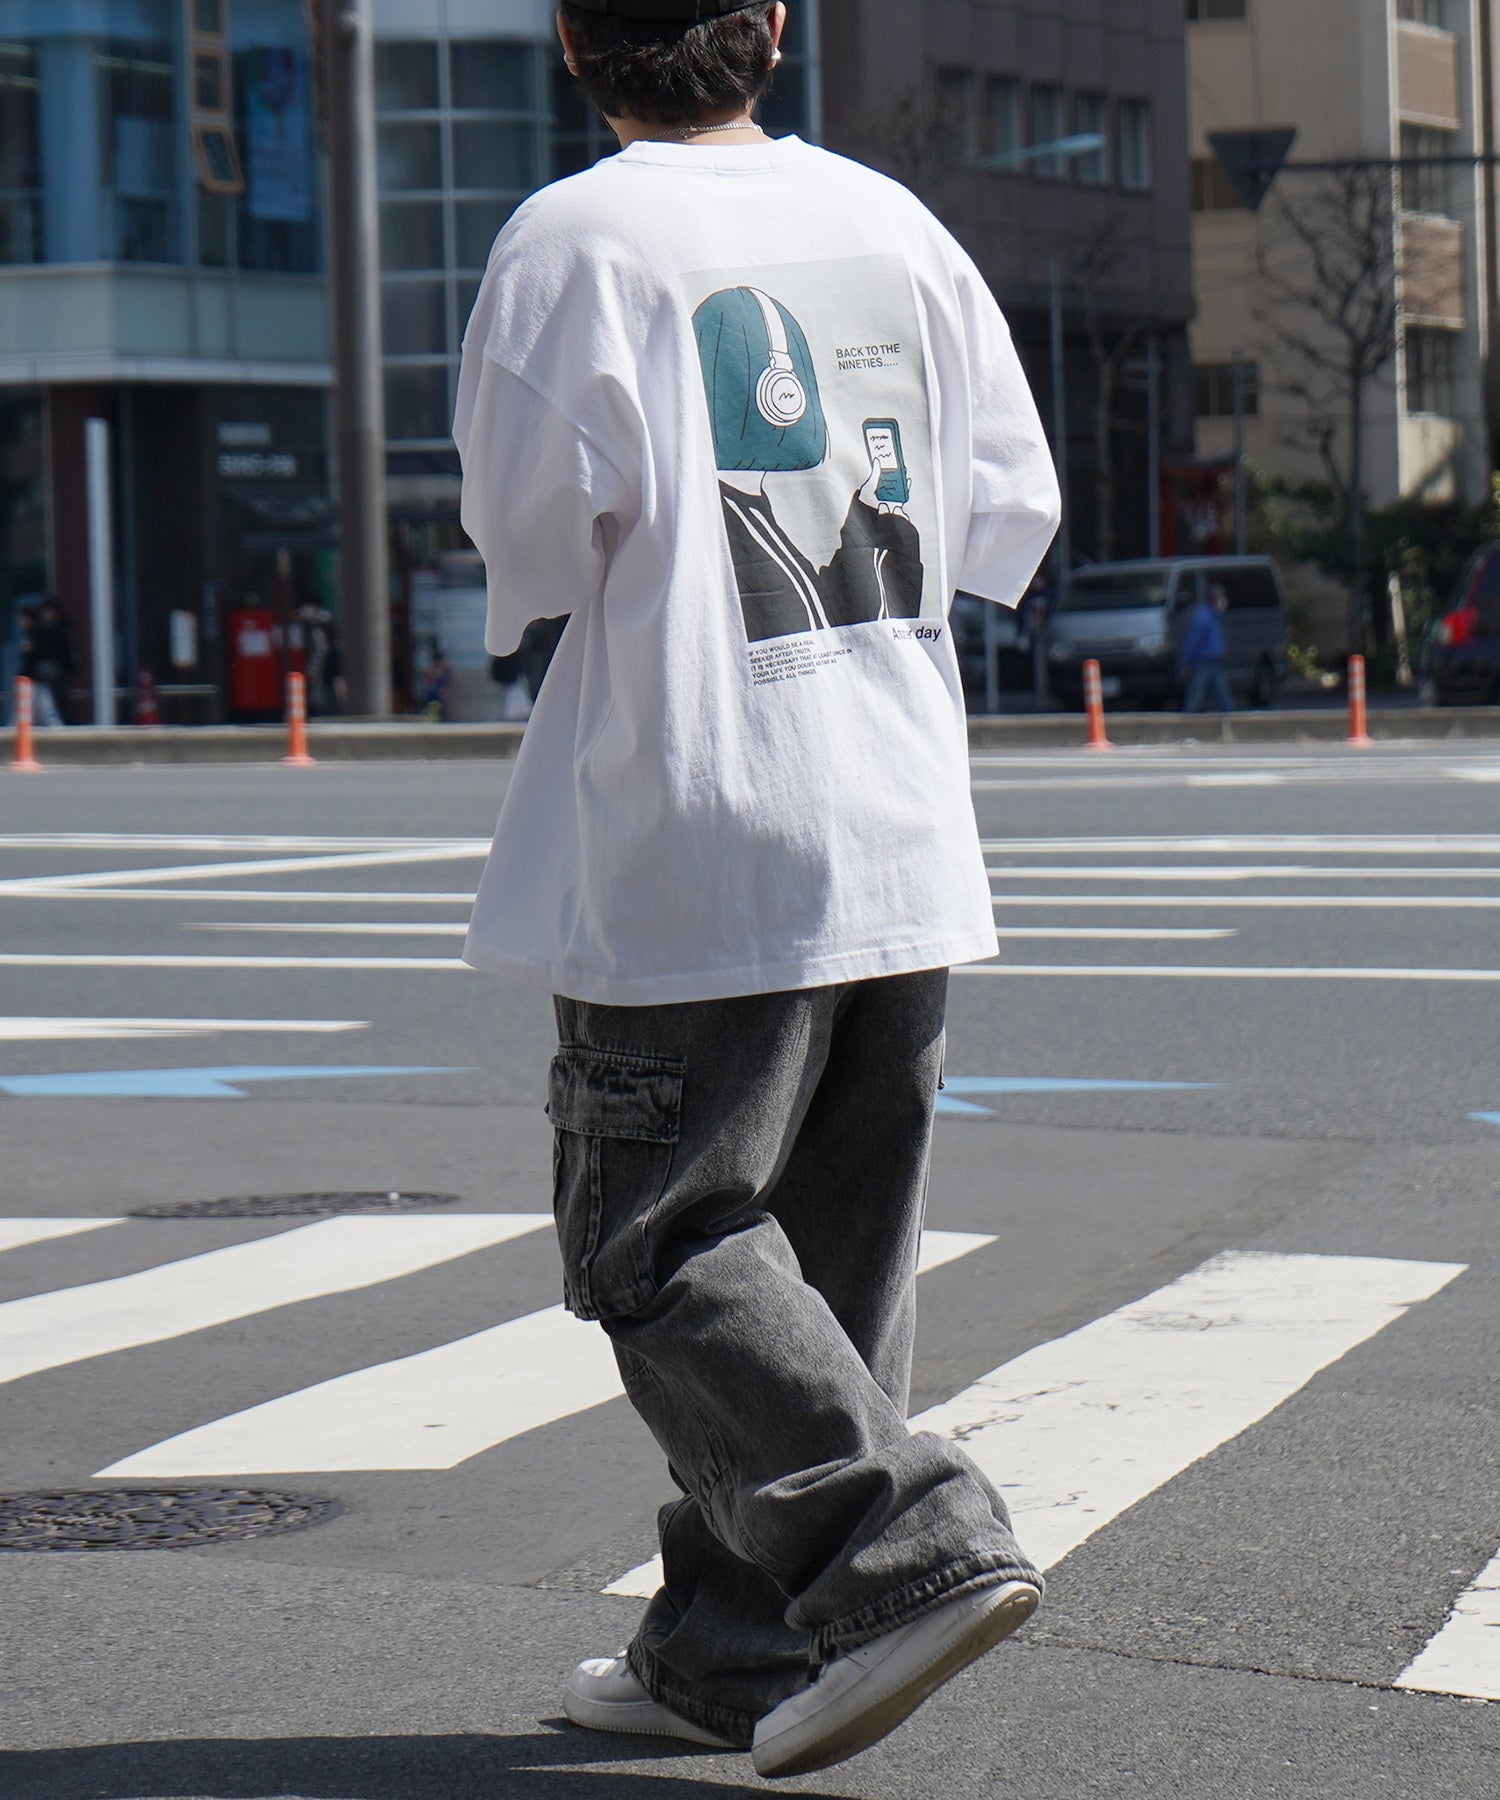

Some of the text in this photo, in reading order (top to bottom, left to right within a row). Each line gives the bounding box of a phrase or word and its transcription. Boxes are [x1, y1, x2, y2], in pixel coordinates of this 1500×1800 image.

[836, 343, 900, 358] BACK TO THE
[915, 626, 942, 642] day
[755, 648, 768, 656] YOU
[769, 644, 791, 652] WOULD
[750, 655, 774, 664] SEEKER
[774, 651, 794, 659] AFTER
[765, 657, 799, 668] NECESSARY
[752, 671, 770, 679] YOUR
